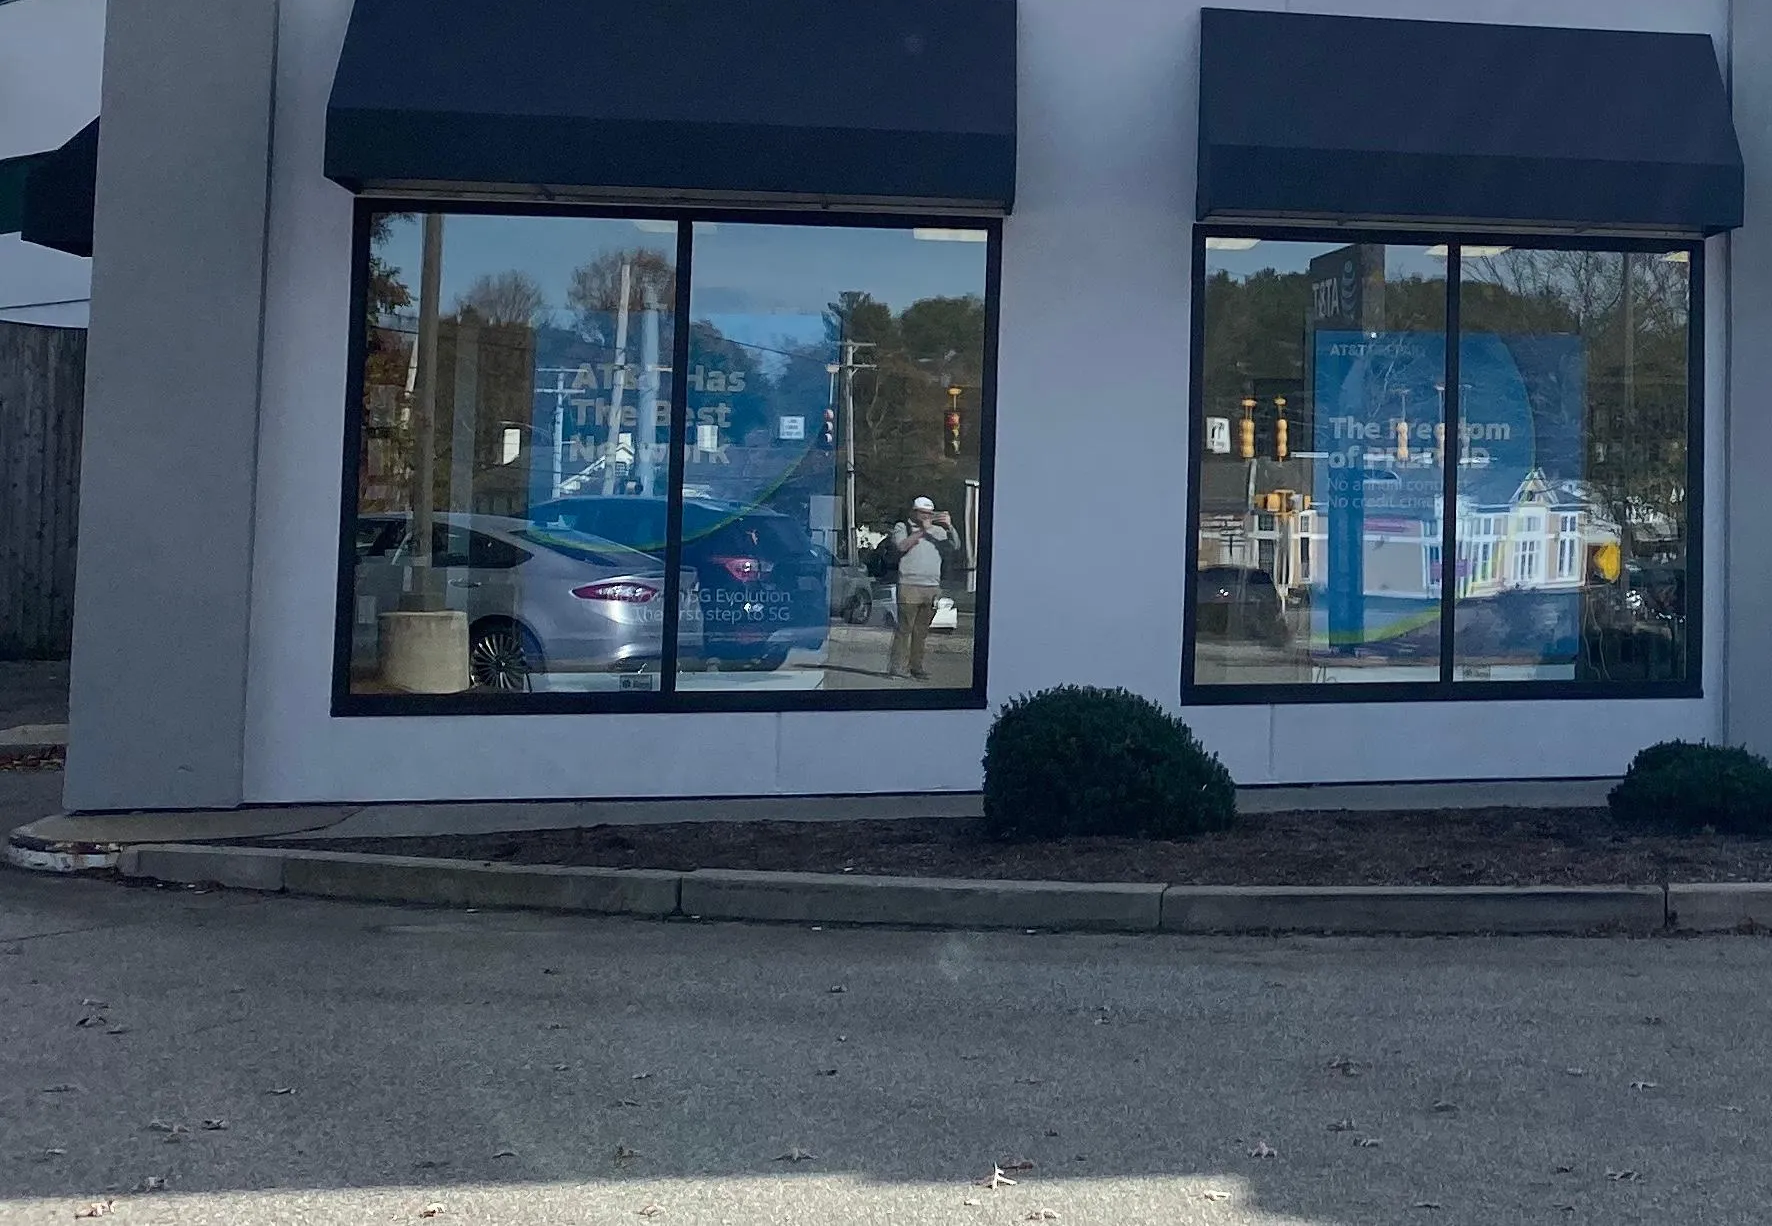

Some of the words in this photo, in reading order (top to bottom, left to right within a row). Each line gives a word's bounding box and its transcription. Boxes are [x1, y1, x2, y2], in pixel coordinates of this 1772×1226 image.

[1329, 343, 1365, 356] AT&T
[1329, 416, 1382, 440] The
[1389, 417, 1511, 441] Freom
[1328, 445, 1360, 469] of
[1328, 478, 1349, 492] No
[1328, 496, 1349, 509] No
[716, 587, 791, 607] Evolution
[705, 607, 740, 624] step
[768, 606, 790, 622] 5G
